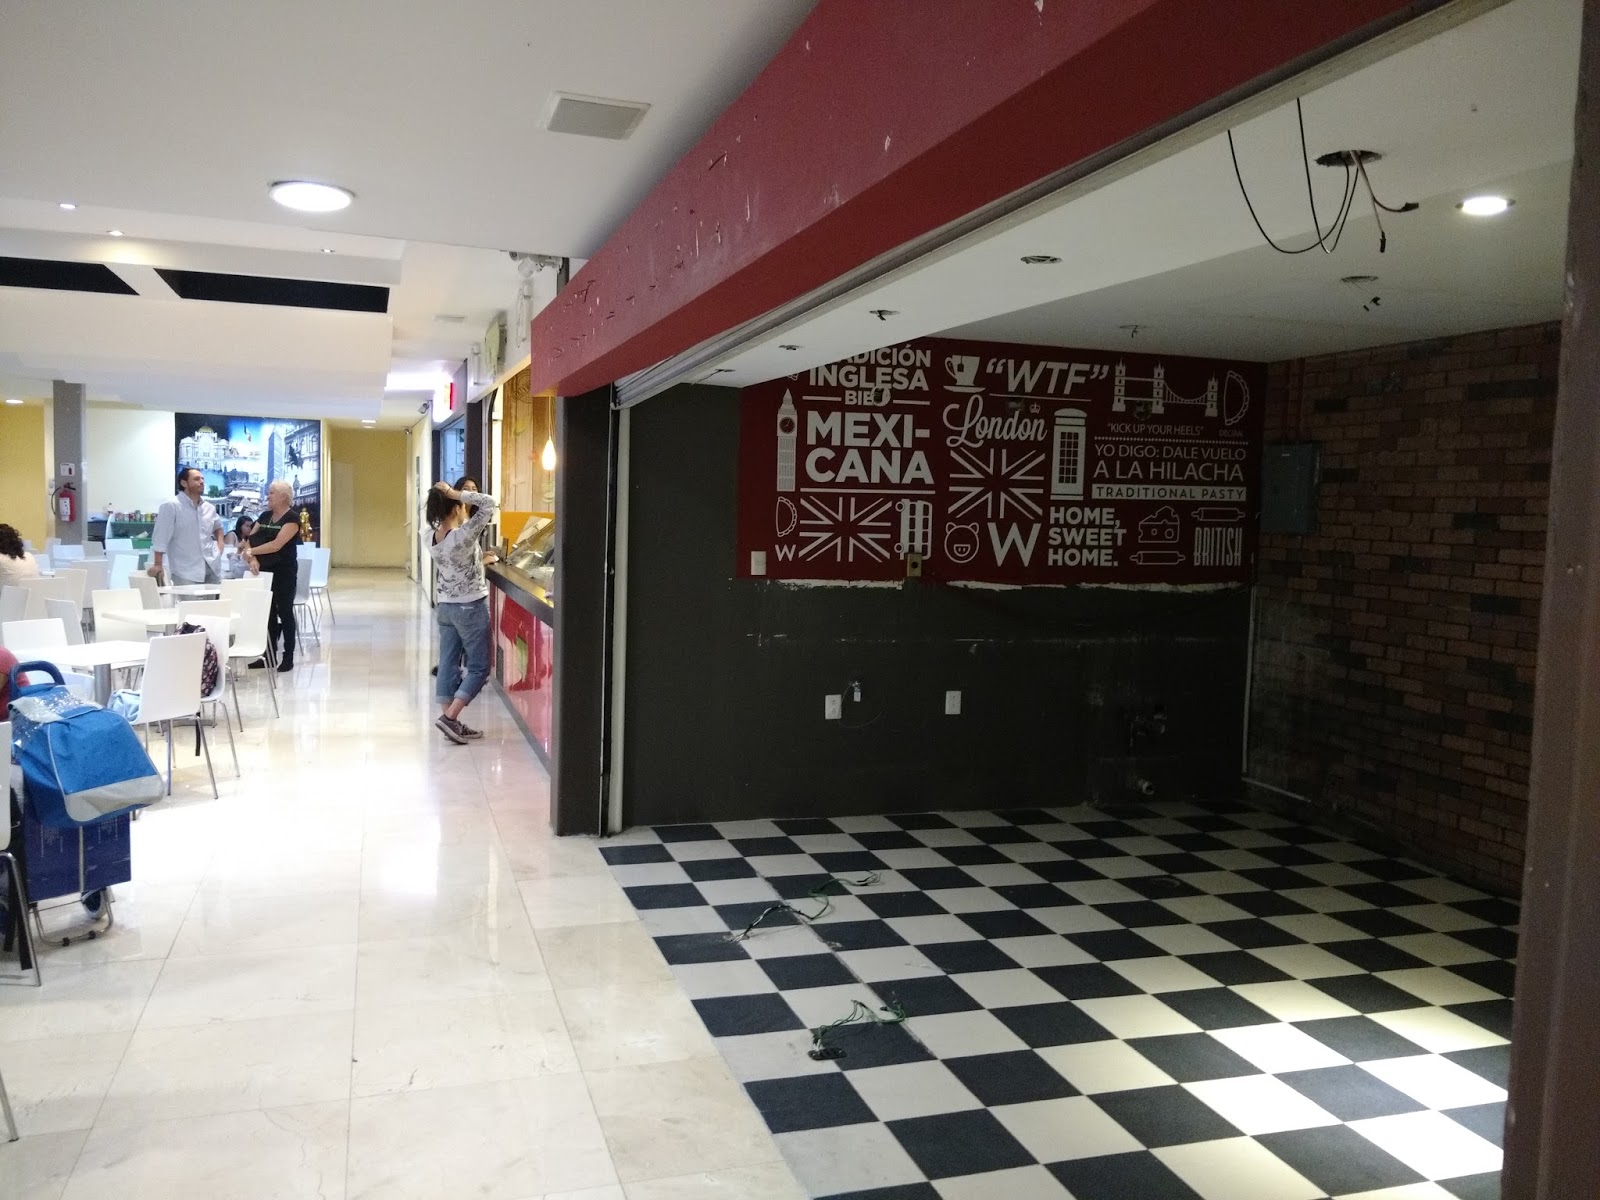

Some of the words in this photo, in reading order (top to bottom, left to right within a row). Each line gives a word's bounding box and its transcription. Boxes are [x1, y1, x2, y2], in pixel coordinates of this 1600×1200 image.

[809, 365, 930, 391] INGLESA
[806, 410, 931, 449] MEXI-
[942, 394, 1048, 448] London
[1133, 423, 1146, 434] UP
[1147, 424, 1173, 435] YOUR
[1094, 444, 1116, 457] YO
[1162, 446, 1199, 459] DALE
[1201, 448, 1247, 460] VUELO
[805, 447, 935, 485] CANA
[1093, 460, 1110, 478] A
[1115, 460, 1143, 479] LA
[1149, 461, 1245, 482] HILACHA
[1096, 486, 1196, 499] TRADITIONAL
[1201, 488, 1245, 500] PASTY
[1047, 527, 1127, 546] SWEET
[1193, 527, 1243, 567] BRITISH
[1047, 548, 1119, 567] HOME.
